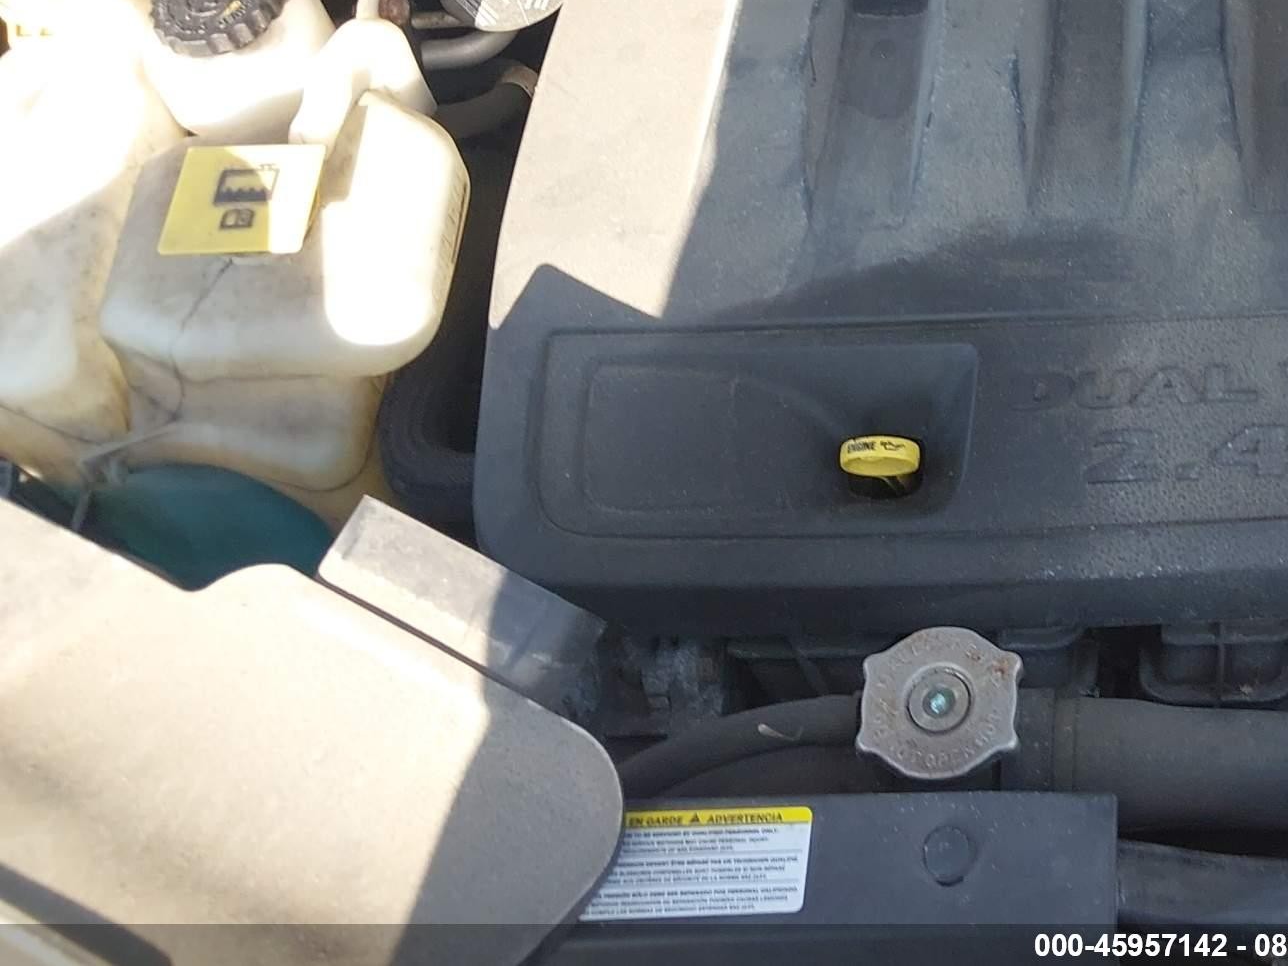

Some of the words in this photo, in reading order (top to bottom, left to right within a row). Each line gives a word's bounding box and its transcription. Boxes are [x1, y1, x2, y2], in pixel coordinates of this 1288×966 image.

[1004, 361, 1259, 411] DUAL
[629, 817, 647, 827] EN
[648, 814, 684, 826] GARDE
[707, 811, 784, 824] ADVERTENCIA
